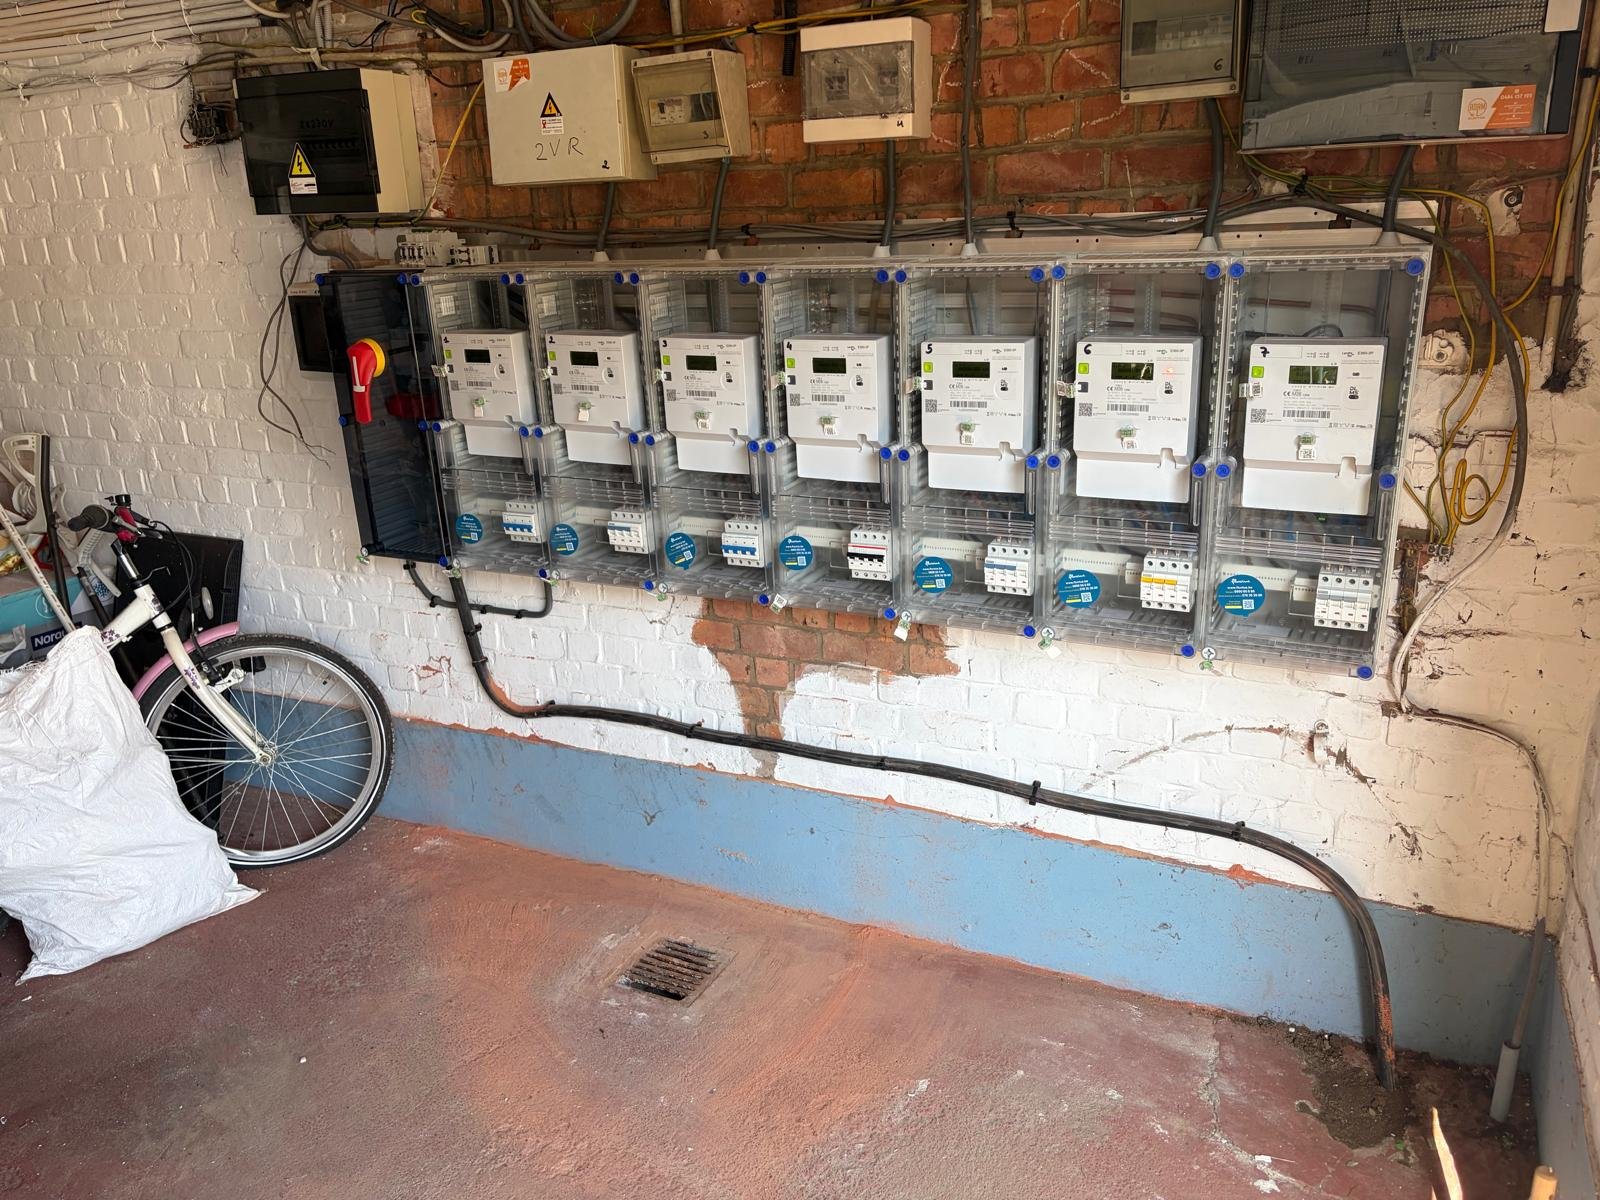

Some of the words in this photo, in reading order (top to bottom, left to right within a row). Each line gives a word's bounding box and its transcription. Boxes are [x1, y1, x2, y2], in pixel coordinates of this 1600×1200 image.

[1213, 58, 1223, 71] 6
[602, 160, 610, 170] 2
[548, 335, 556, 344] 2
[662, 340, 668, 348] 3
[786, 341, 793, 351] 4
[925, 343, 933, 354] 5
[1084, 343, 1093, 355] 6
[1259, 346, 1270, 358] 7
